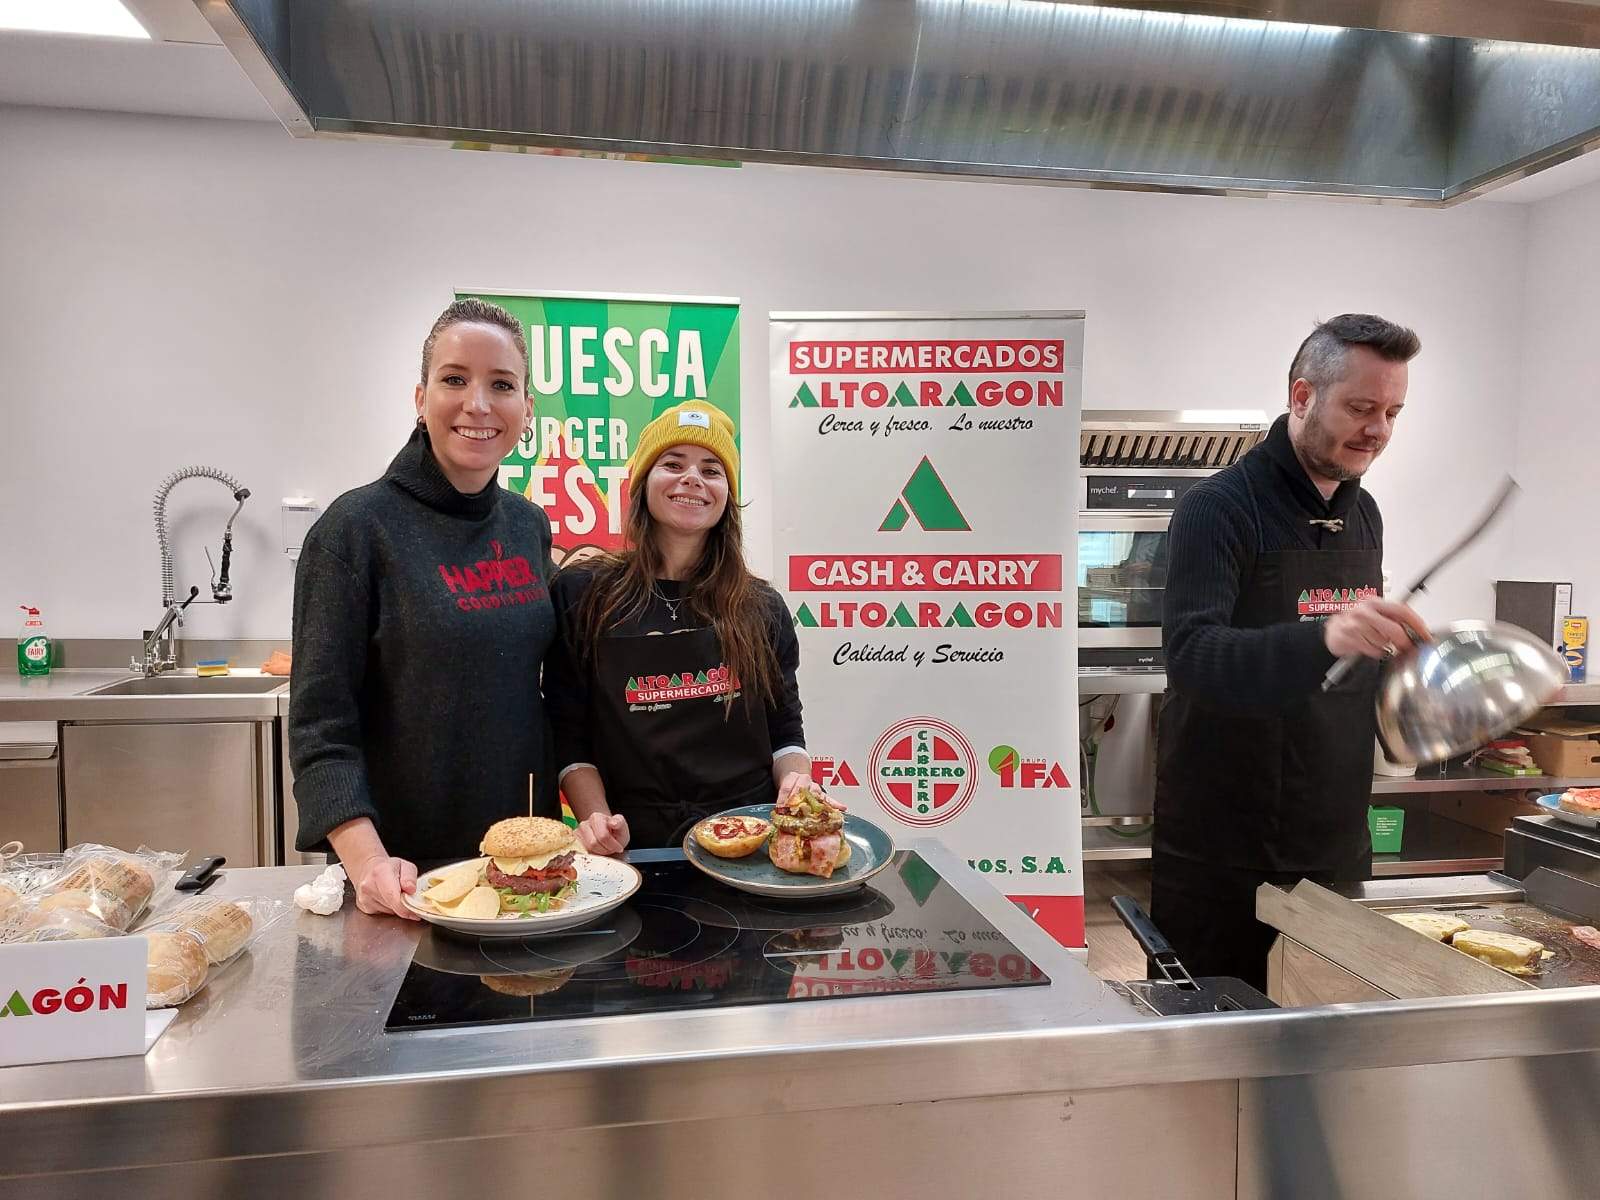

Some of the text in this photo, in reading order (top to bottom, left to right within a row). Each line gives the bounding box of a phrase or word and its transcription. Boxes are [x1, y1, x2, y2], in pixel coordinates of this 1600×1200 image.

[531, 324, 707, 398] UESCA
[794, 344, 1059, 369] SUPERMERCADOS
[788, 380, 1064, 408] ALTOARAGON
[504, 416, 629, 460] URGER
[818, 413, 863, 435] Cerca
[869, 420, 880, 437] y
[948, 413, 973, 431] Lo
[978, 415, 1034, 431] nuestro
[807, 559, 1040, 586] CASH & CARRY
[792, 600, 1063, 628] ALTOARAGON
[832, 641, 1004, 667] Calidad y Servicio
[637, 680, 731, 701] SUPERMERCADOS
[811, 760, 860, 787] FA
[880, 767, 966, 778] CABRERO
[916, 730, 930, 814] CABRERO
[1021, 856, 1072, 874] S.A.
[0, 977, 128, 1018] AGÓN
